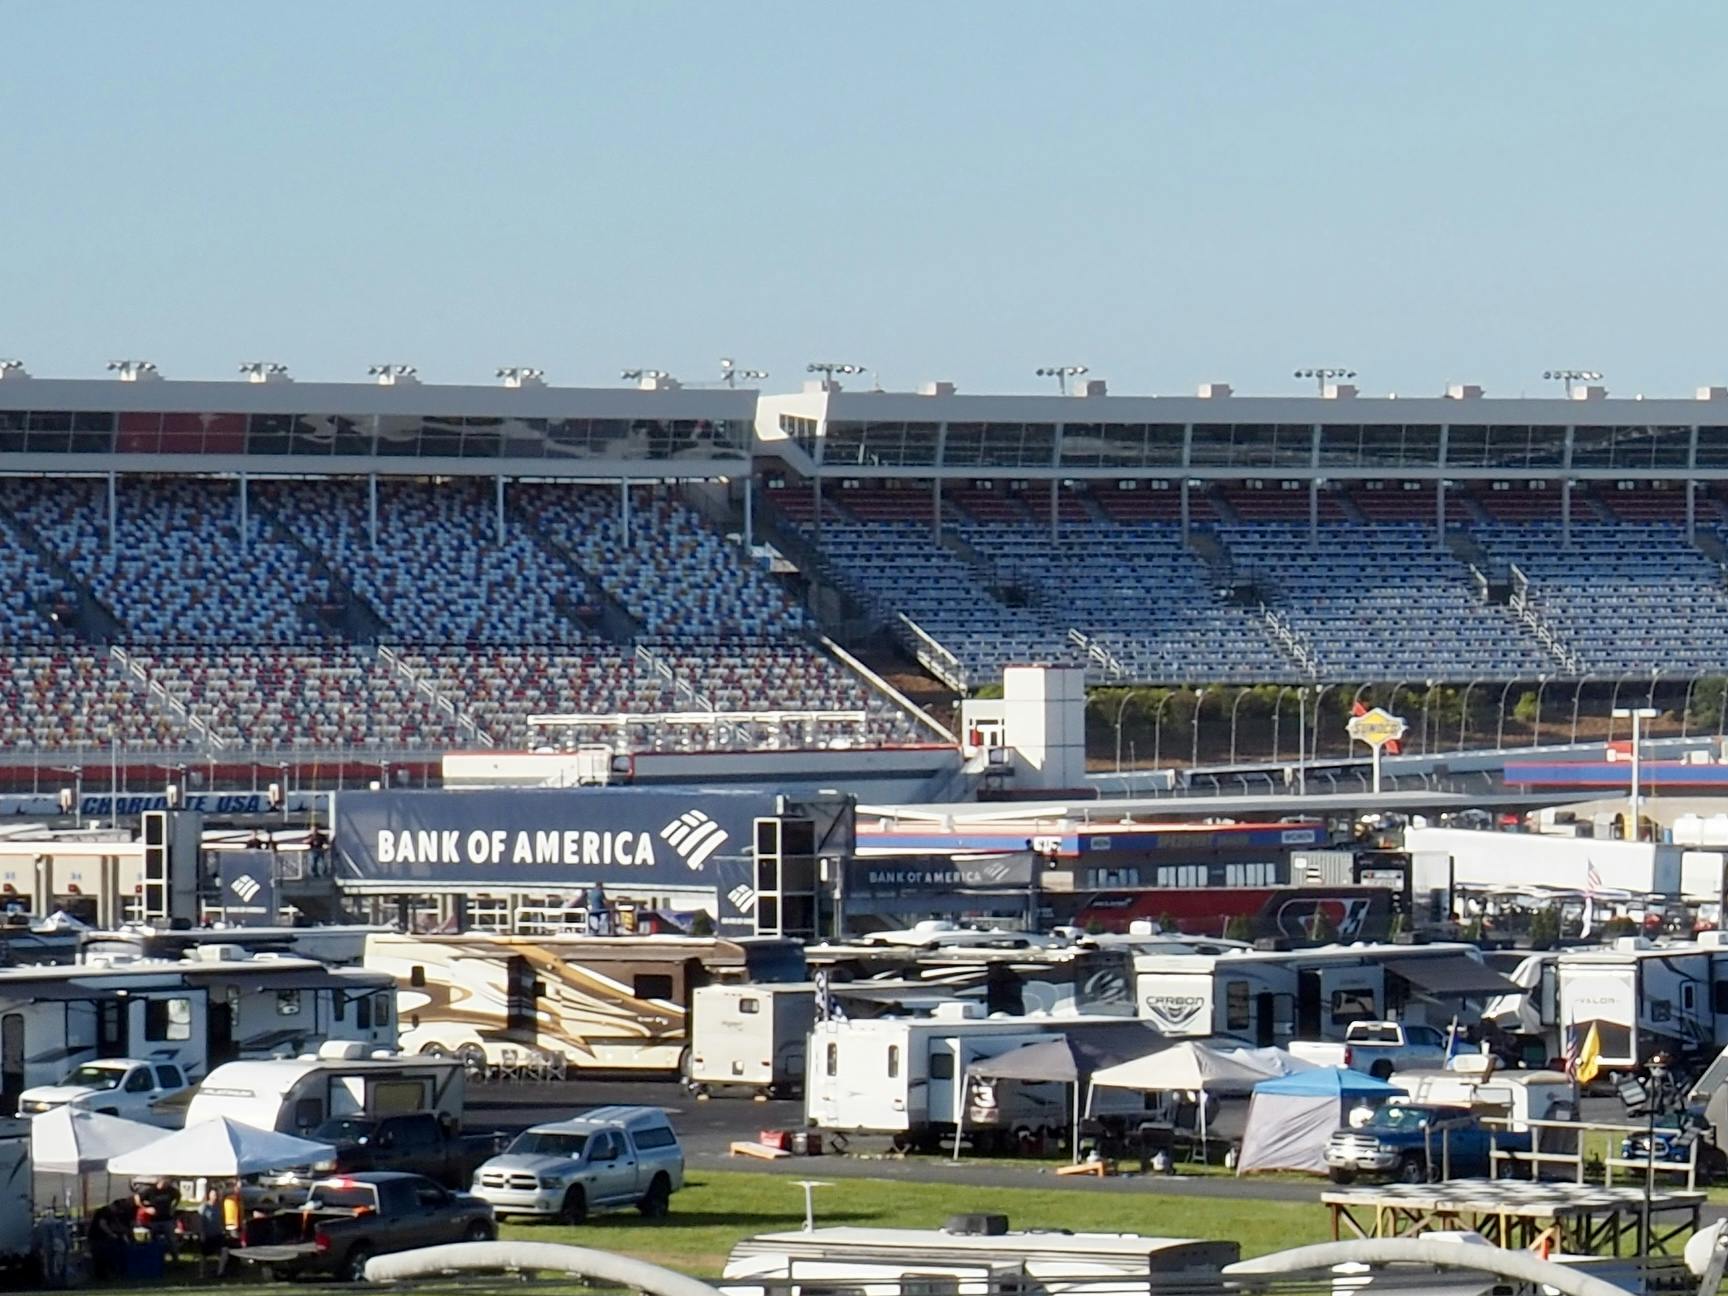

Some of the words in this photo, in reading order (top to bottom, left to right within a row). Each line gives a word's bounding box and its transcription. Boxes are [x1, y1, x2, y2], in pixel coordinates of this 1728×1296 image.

[82, 795, 208, 815] CHARLOTE
[216, 795, 261, 813] USA
[377, 830, 461, 863] BANK
[467, 830, 507, 864] OF
[512, 830, 656, 865] AMERICA
[868, 871, 905, 884] BANK
[907, 871, 923, 884] OF
[924, 871, 982, 884] AMERICA
[1146, 995, 1205, 1006] CARBON
